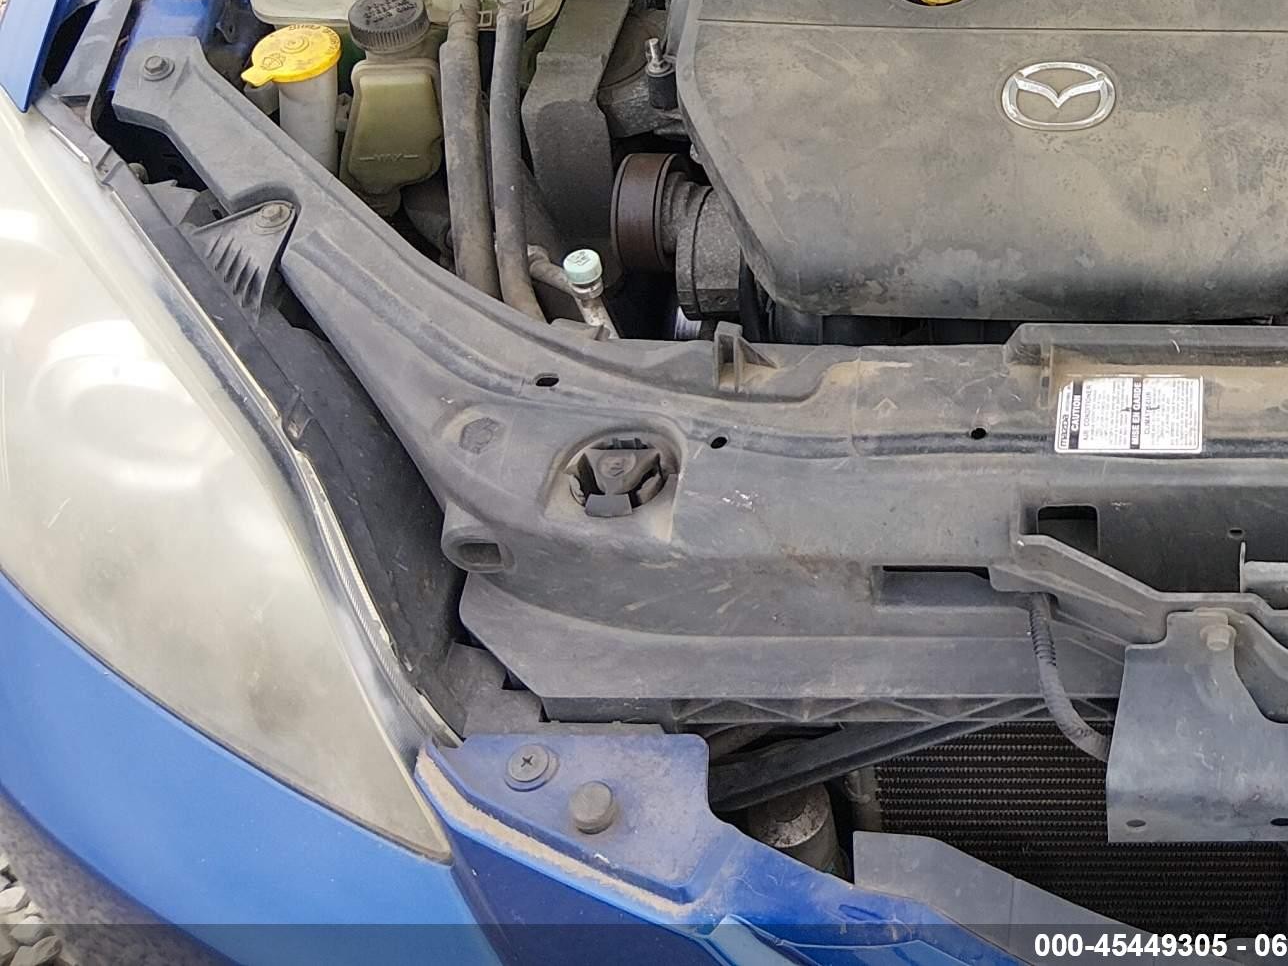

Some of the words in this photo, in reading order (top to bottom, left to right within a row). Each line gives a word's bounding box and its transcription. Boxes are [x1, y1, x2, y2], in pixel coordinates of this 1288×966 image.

[1083, 385, 1092, 427] CONDITIONER
[1132, 382, 1142, 410] GARDE
[1071, 395, 1081, 432] CAUTION
[1132, 412, 1140, 423] EN
[1060, 414, 1070, 447] mazda
[1131, 425, 1139, 445] MISE
